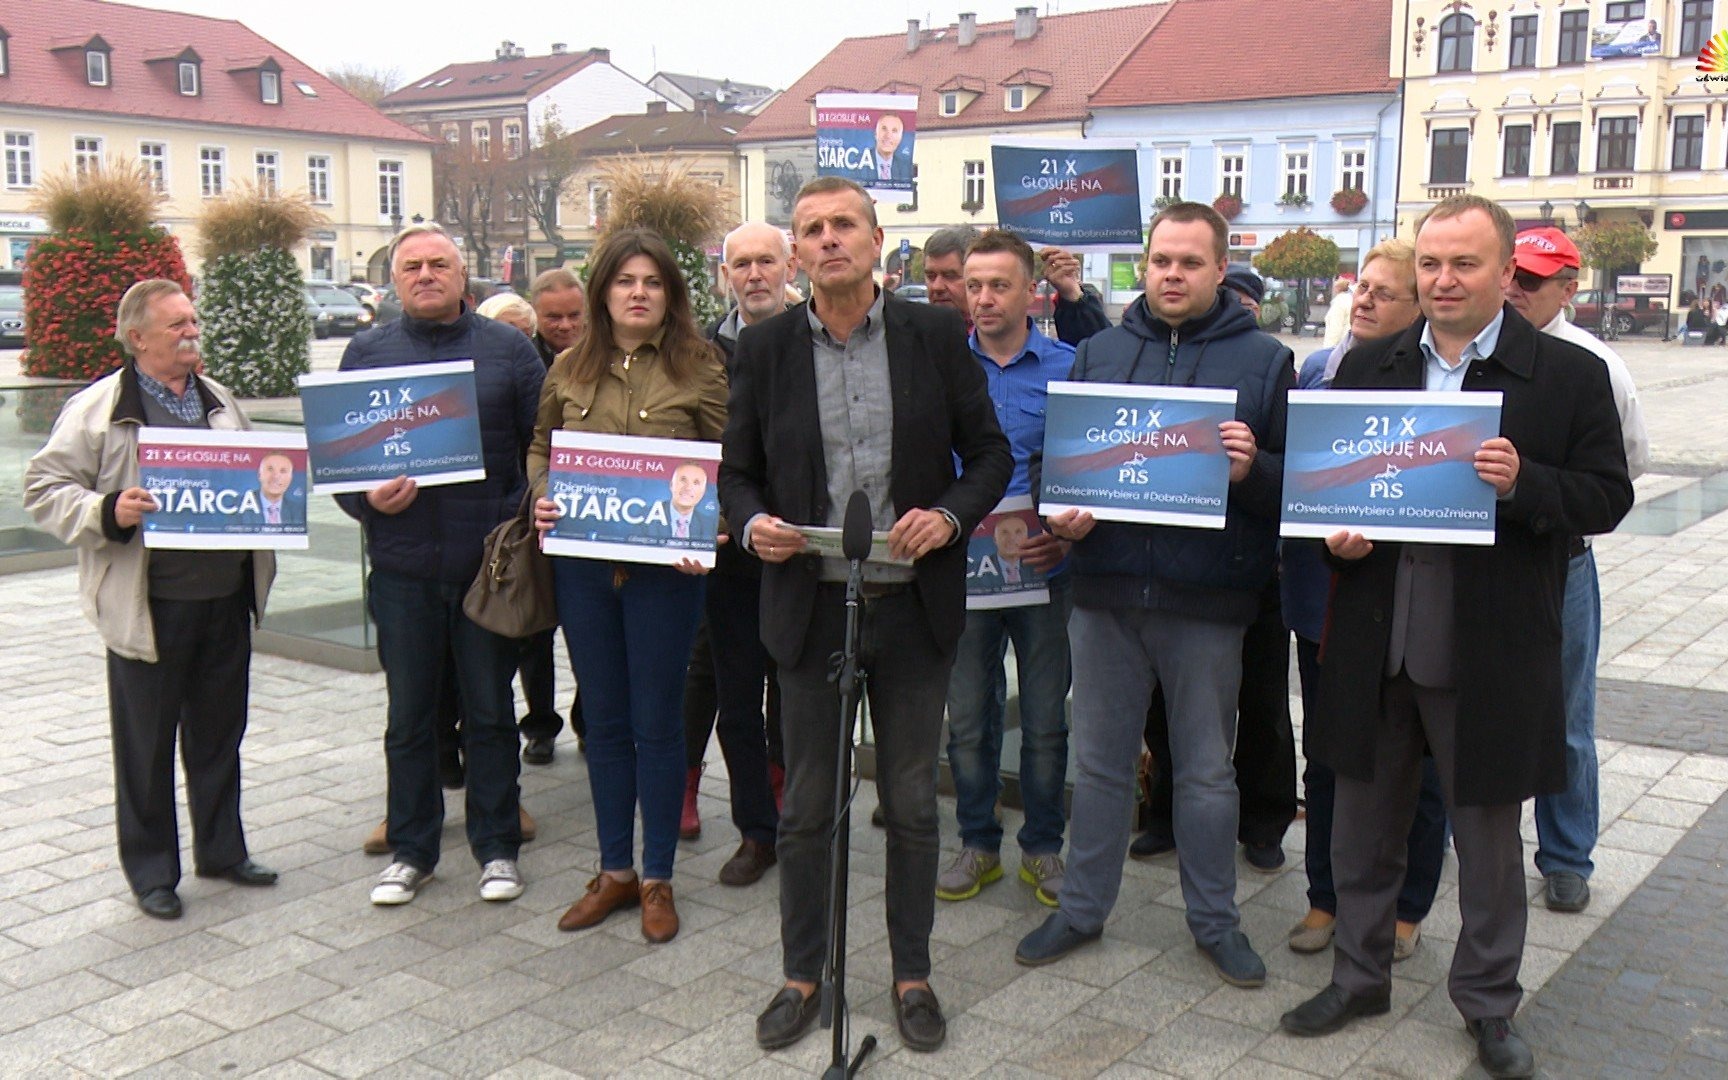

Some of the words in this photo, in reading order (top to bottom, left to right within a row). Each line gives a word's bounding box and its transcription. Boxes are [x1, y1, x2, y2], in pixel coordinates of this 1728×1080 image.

[818, 147, 875, 170] STARCA
[1040, 158, 1058, 175] 21
[1065, 159, 1078, 176] X
[1021, 175, 1078, 194] GŁOSUJĘ
[1081, 179, 1103, 191] NA
[369, 388, 391, 407] 21
[399, 387, 414, 404] X
[344, 406, 414, 426] GŁOSUJĘ
[417, 405, 441, 418] NA
[1114, 407, 1138, 427] 21
[1147, 409, 1162, 428] X
[1363, 415, 1389, 437] 21
[1399, 416, 1417, 437] X
[1086, 427, 1160, 449] GŁOSUJĘ
[1163, 433, 1189, 448] NA
[145, 449, 160, 461] 21
[163, 449, 173, 461] X
[175, 450, 232, 465] GŁOSUJĘ
[233, 452, 252, 463] NA
[1331, 438, 1414, 460] GŁOSUJĘ
[1419, 441, 1448, 456] NA
[556, 453, 570, 465] 21
[574, 455, 583, 466] X
[586, 455, 644, 473] GŁOSUJĘ
[645, 460, 664, 473] NA
[145, 474, 211, 491] Zbigniewa
[553, 480, 618, 497] Zbigniewa
[149, 488, 261, 515] STARCA
[552, 492, 669, 527] STARCA
